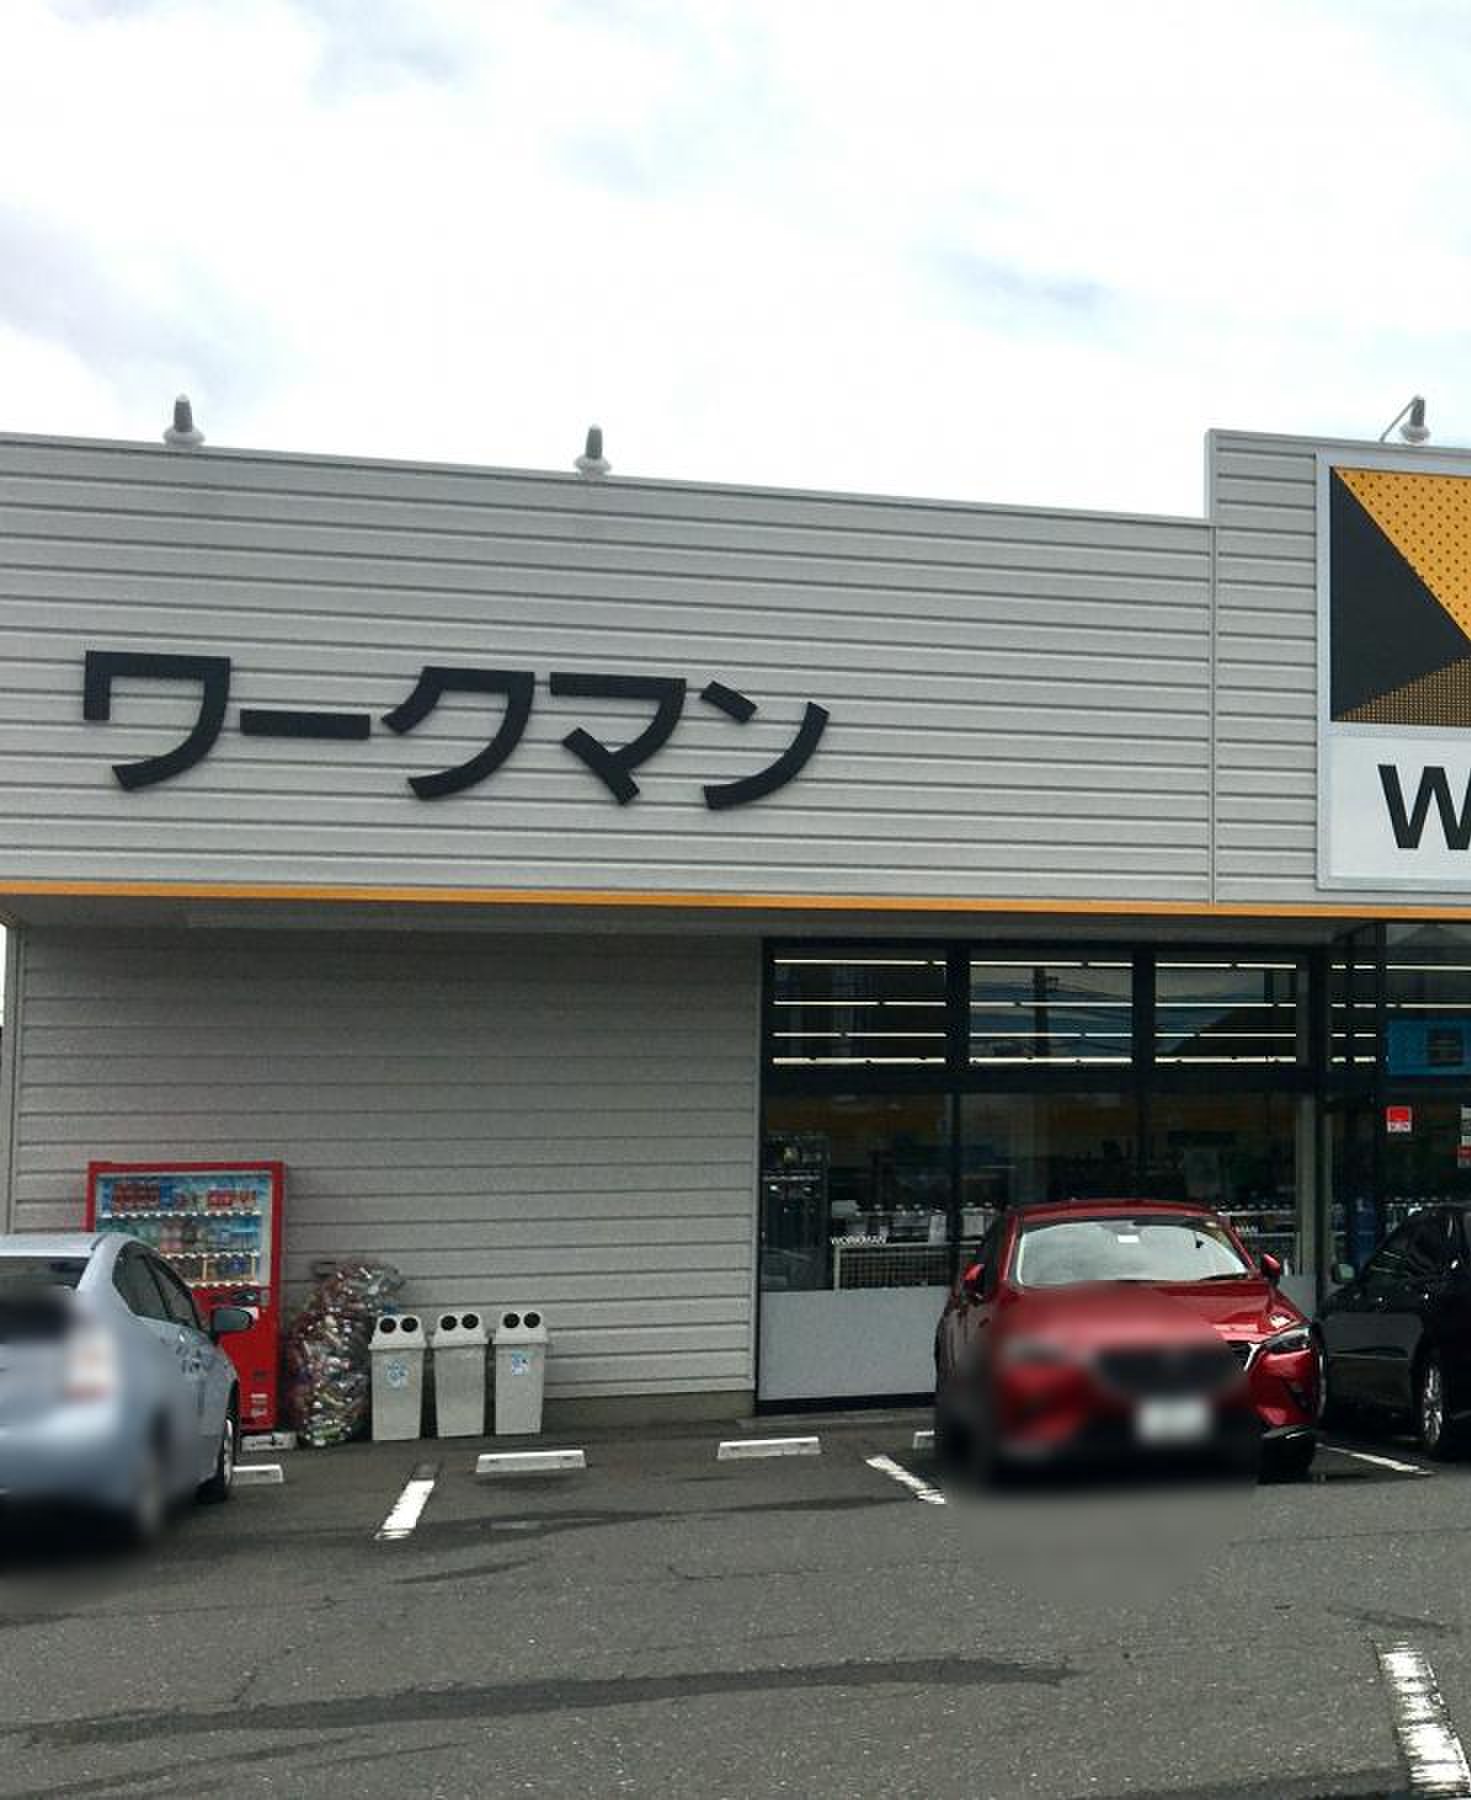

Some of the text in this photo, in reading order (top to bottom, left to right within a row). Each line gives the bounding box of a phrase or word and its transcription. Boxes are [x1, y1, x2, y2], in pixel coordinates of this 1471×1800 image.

[83, 649, 830, 810] ワークマン
